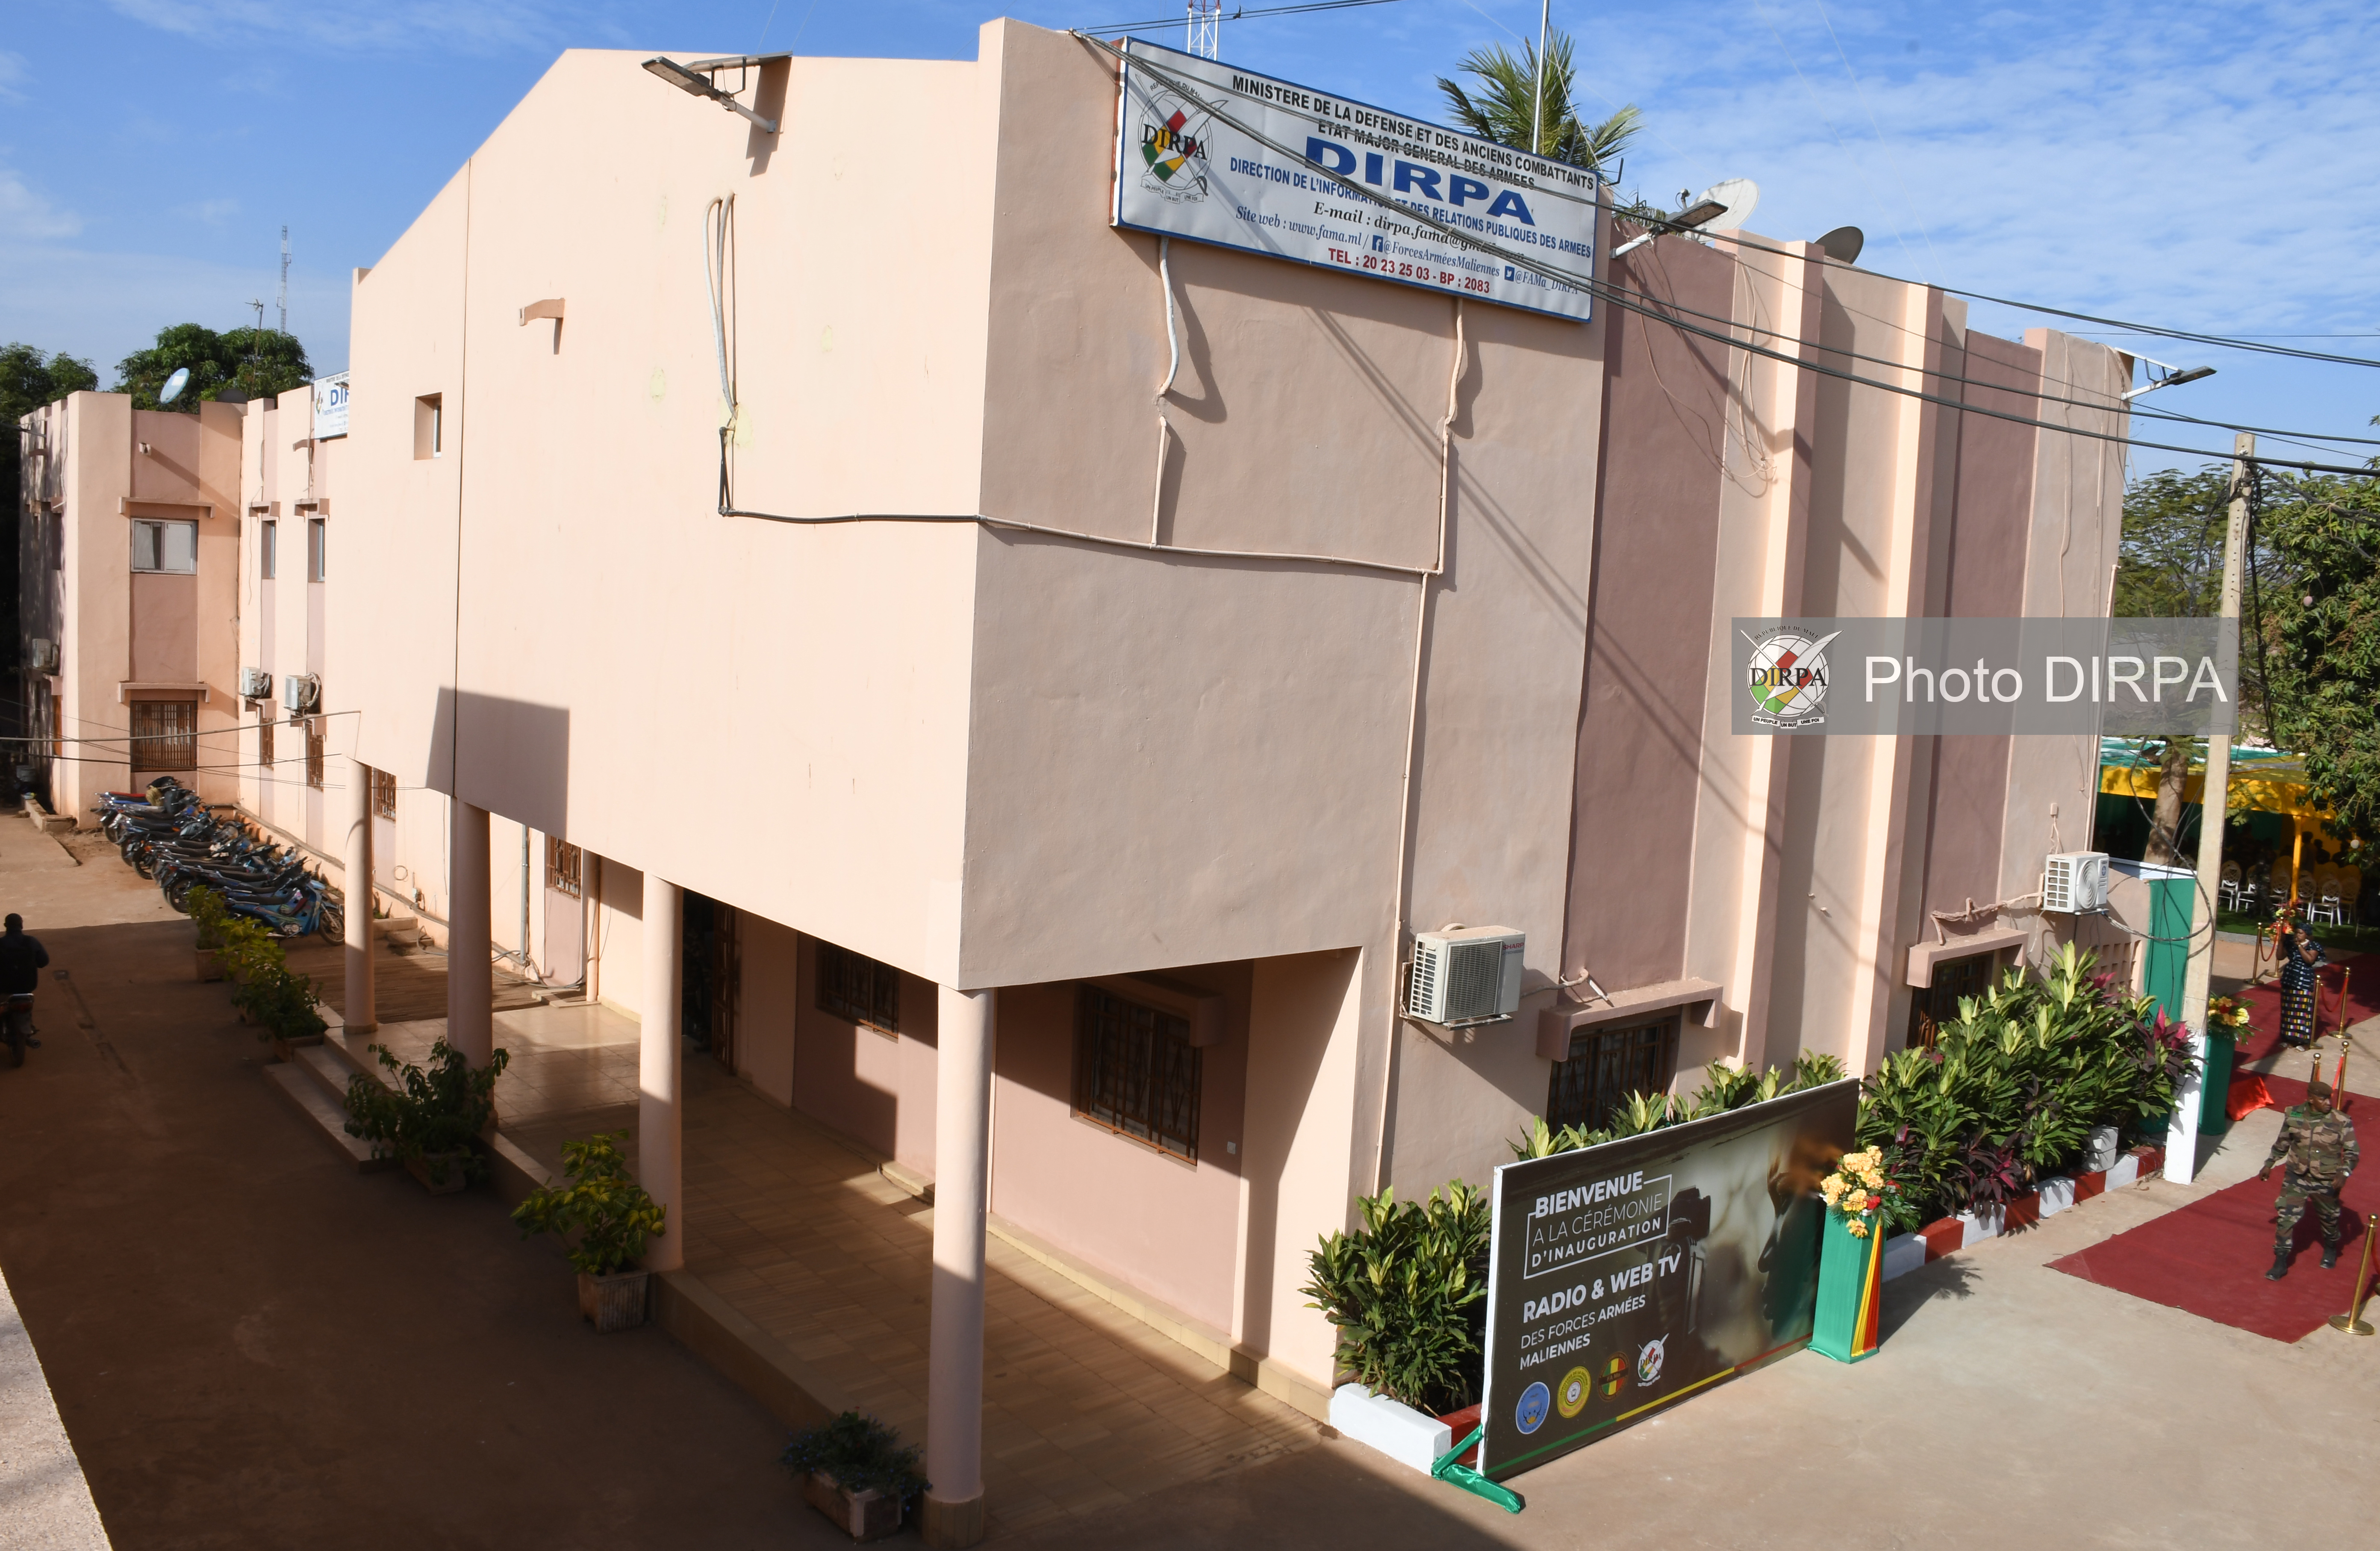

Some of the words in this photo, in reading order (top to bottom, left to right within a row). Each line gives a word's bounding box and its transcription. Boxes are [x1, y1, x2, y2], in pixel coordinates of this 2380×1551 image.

[1141, 123, 1208, 161] DIRPA
[1233, 75, 1309, 110] MINISTERE
[1314, 97, 1331, 116] DE
[1335, 104, 1351, 122] LA
[1355, 109, 1413, 139] DEFENSE
[1417, 127, 1432, 143] ET
[1435, 132, 1459, 151] DES
[1462, 141, 1512, 167] ANCIENS
[1515, 156, 1594, 191] COMBATTANTS
[1318, 118, 1351, 140] ETAT
[1354, 129, 1399, 153] MAJOR
[1403, 142, 1461, 170] GENERAL
[1464, 158, 1486, 177] DES
[1488, 166, 1535, 190] ARMEES
[1230, 156, 1290, 185] DIRECTION
[1293, 173, 1308, 190] DE
[1411, 201, 1429, 217] DES
[1432, 207, 1484, 232] RELATIONS
[1486, 220, 1537, 245] PUBLIQUES
[1540, 233, 1556, 250] DES
[1558, 239, 1591, 259] ARMEES
[1304, 136, 1536, 227] DIRPA
[1313, 201, 1363, 225] E-mail
[1236, 205, 1257, 222] Site
[1259, 210, 1280, 228] web
[1289, 221, 1362, 246] www.fama.ml
[1384, 240, 1500, 277] @ForcesArméesMaliennes
[1328, 248, 1351, 265] TEL
[1363, 254, 1377, 270] 20
[1381, 258, 1395, 274] 23
[1398, 262, 1414, 277] 25
[1416, 264, 1430, 280] 03
[1440, 271, 1455, 286] BP
[1464, 276, 1490, 294] 2083
[1532, 1228, 1544, 1247] A
[1549, 1221, 1568, 1243] LA
[1572, 1192, 1663, 1235] CÉRÉMONIE
[1535, 1171, 1644, 1219] BIENVENUE
[1532, 1217, 1661, 1268] D’INAUGURATION
[1523, 1284, 1587, 1324] RADIO
[1591, 1279, 1605, 1300] &
[1610, 1262, 1653, 1294] WEB
[1658, 1252, 1681, 1276] TV
[1521, 1328, 1545, 1349] DES
[1548, 1311, 1596, 1340] FORCES
[1597, 1294, 1647, 1324] ARMÉES
[1520, 1333, 1591, 1370] MALIENNES
